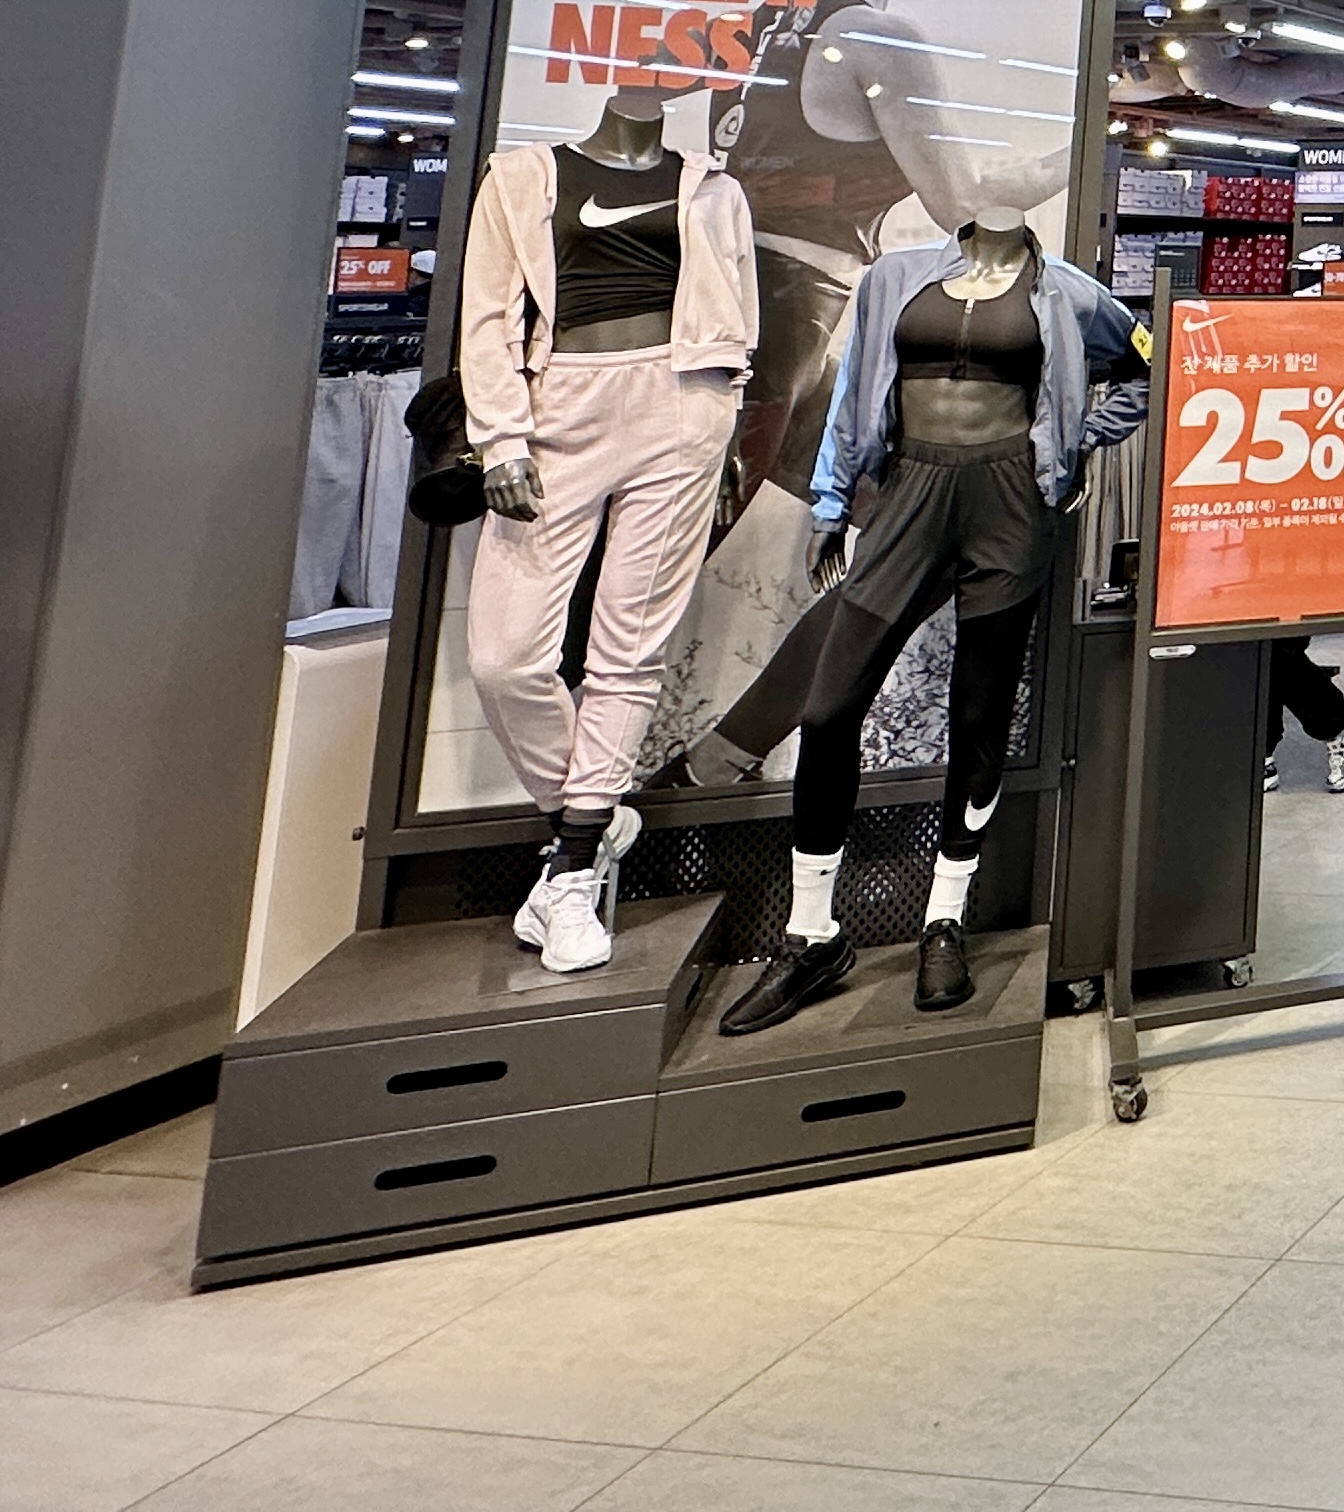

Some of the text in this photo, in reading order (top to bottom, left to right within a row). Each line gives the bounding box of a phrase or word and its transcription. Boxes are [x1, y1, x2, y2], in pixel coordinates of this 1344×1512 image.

[546, 3, 754, 91] NESS
[367, 260, 391, 275] OFF
[1243, 354, 1280, 374] 추가
[1284, 352, 1318, 373] 할인
